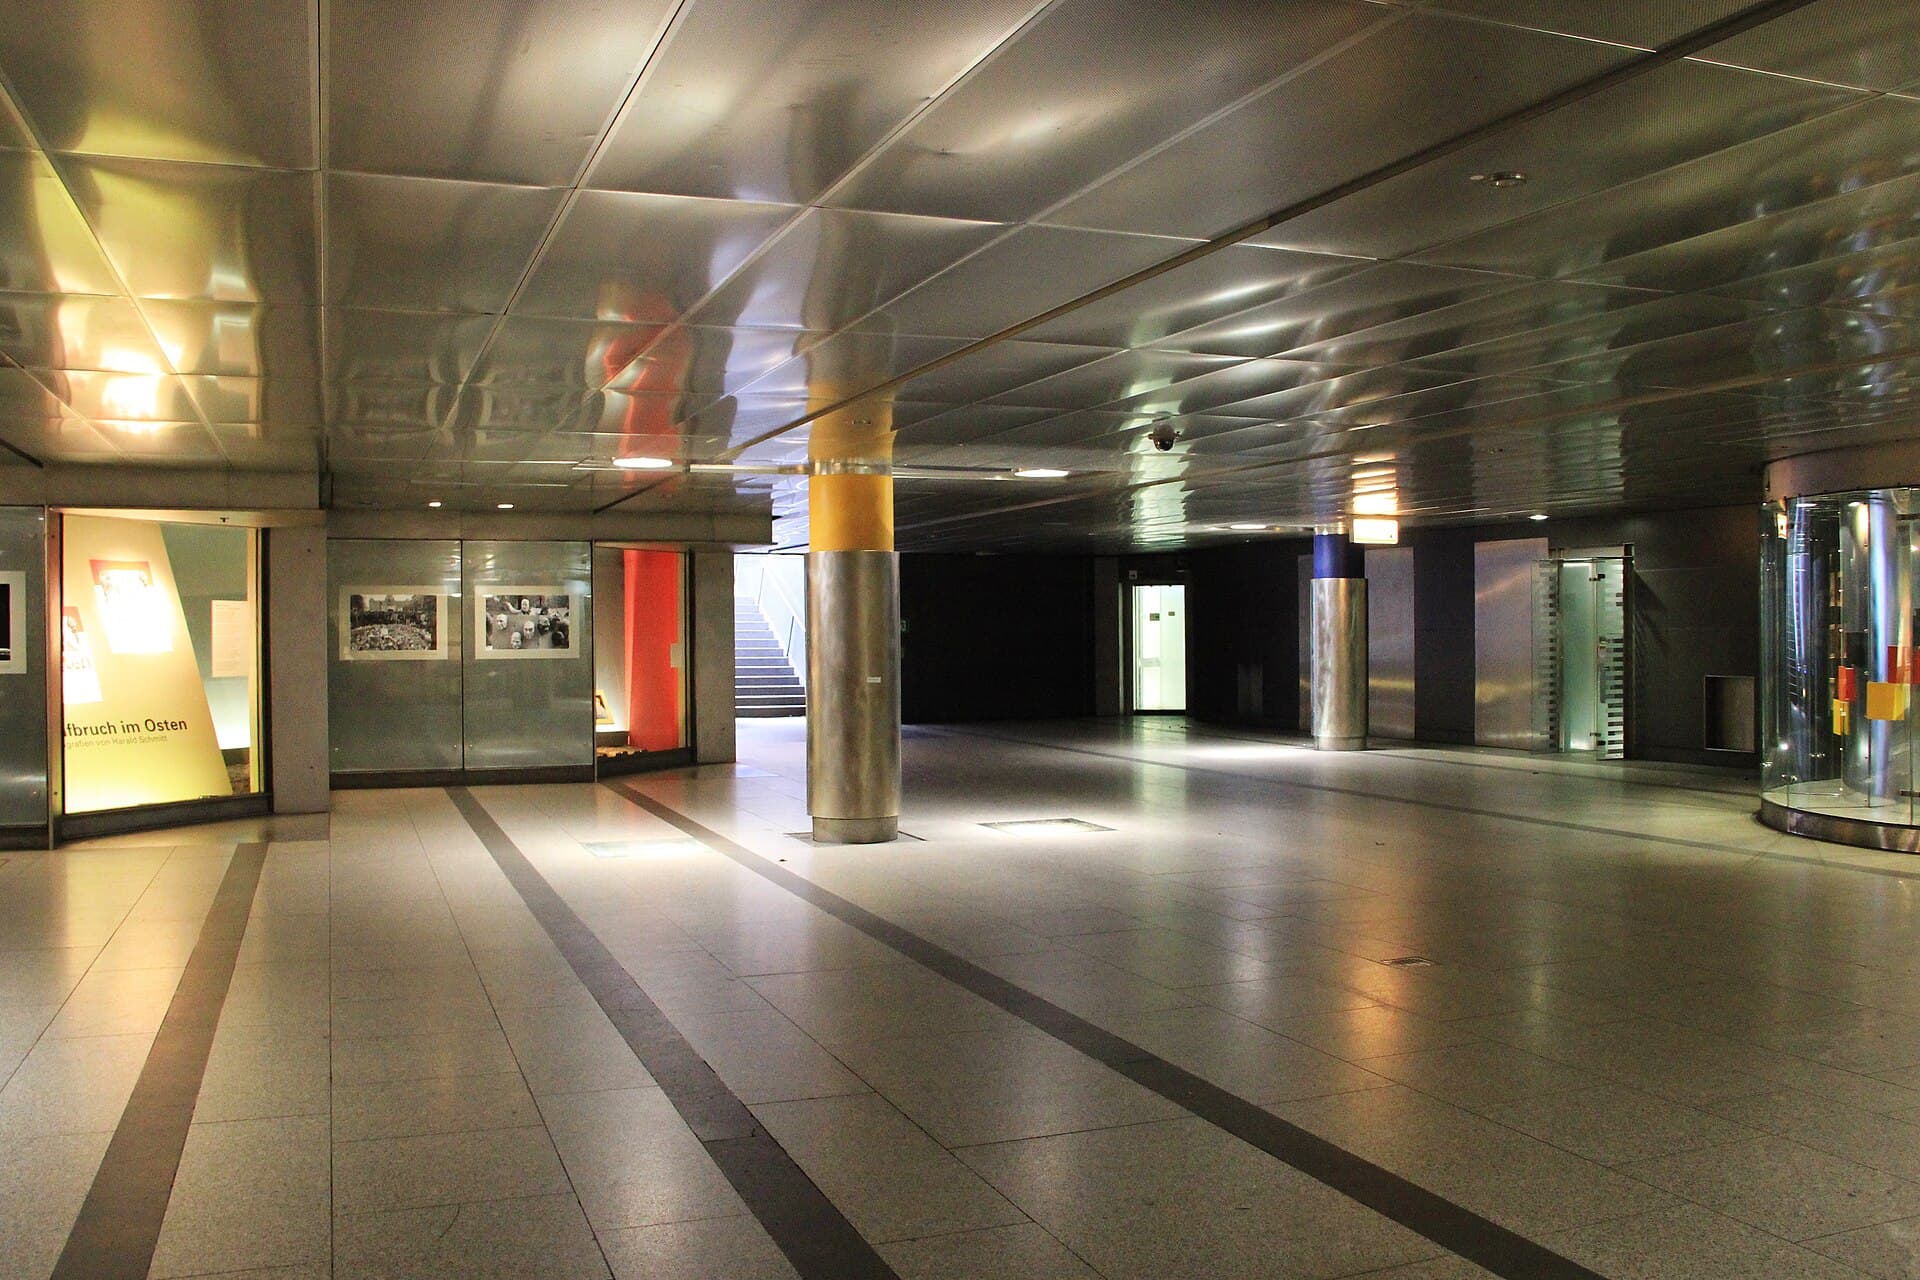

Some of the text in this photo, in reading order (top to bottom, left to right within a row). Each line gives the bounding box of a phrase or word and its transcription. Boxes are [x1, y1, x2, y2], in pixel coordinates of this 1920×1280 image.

[65, 718, 188, 737] fbruch im Osten
[66, 739, 95, 749] grafien
